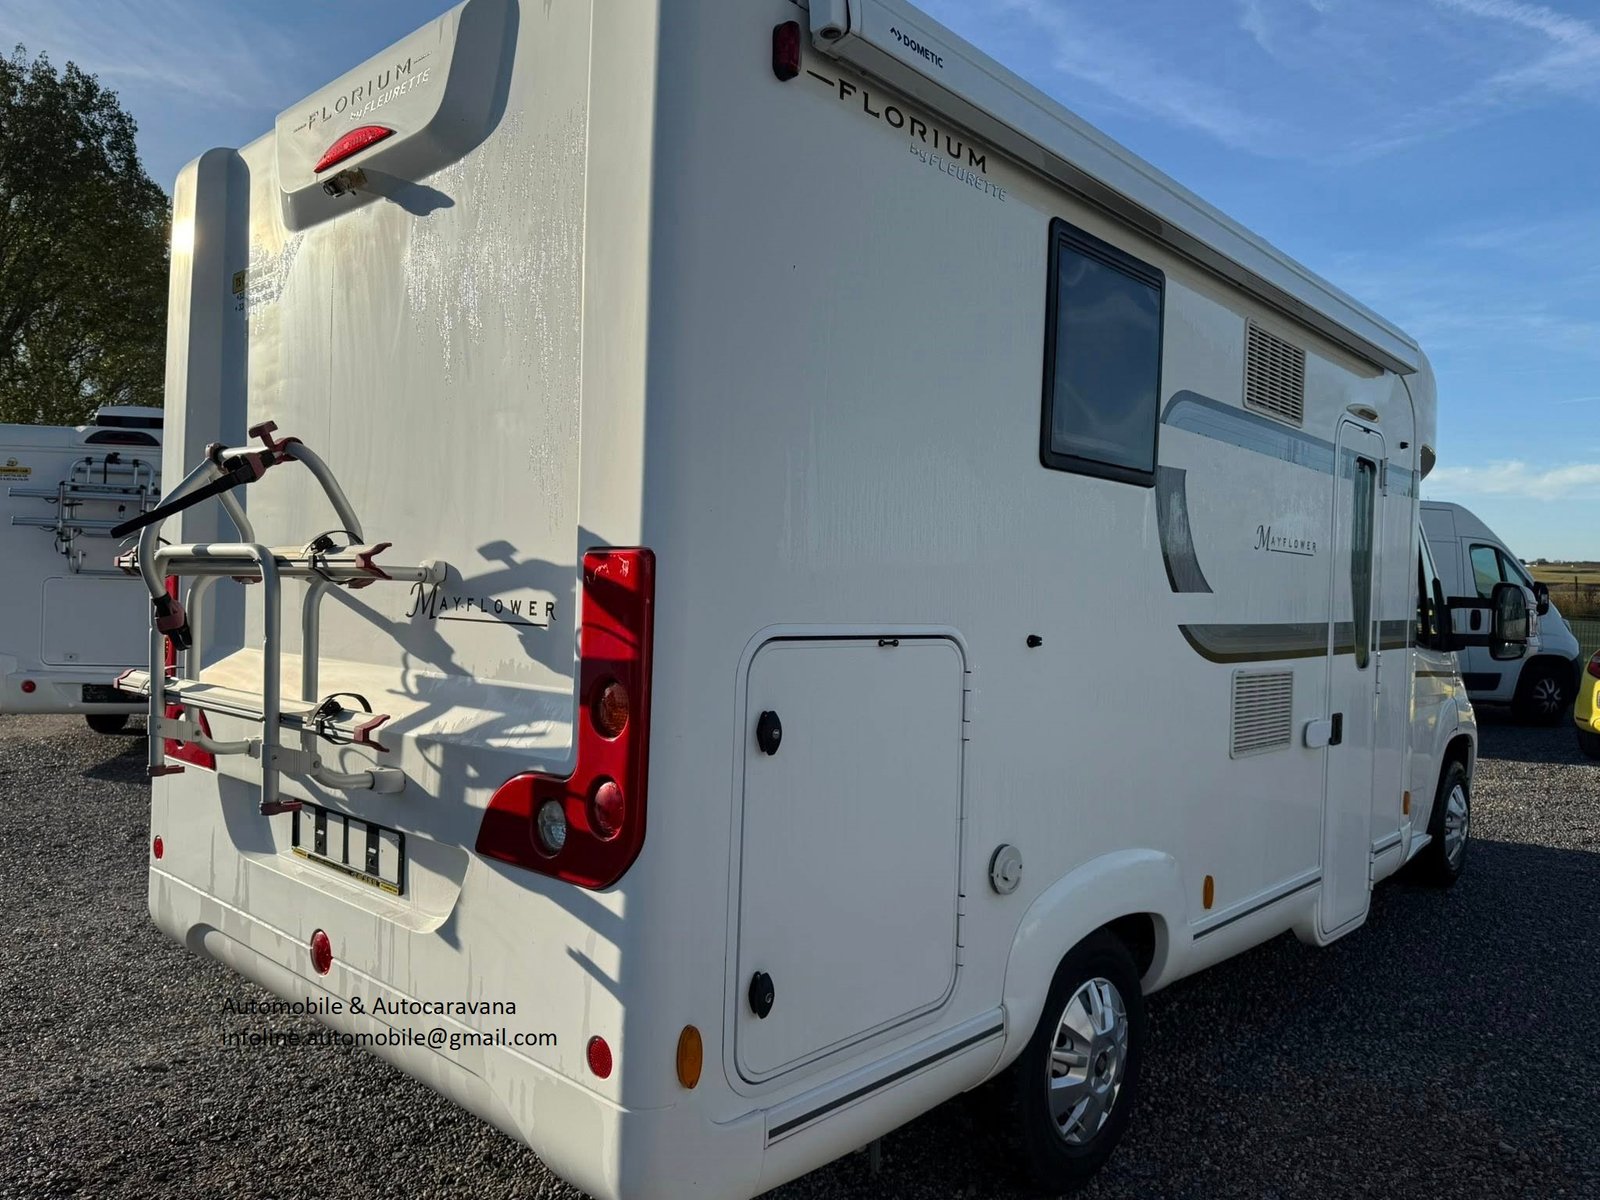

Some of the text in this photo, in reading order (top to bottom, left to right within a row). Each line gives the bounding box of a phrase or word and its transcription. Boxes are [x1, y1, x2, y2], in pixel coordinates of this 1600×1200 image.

[903, 34, 944, 69] DOMETIC
[308, 57, 411, 130] FLORIUM
[362, 67, 430, 117] FLEURETTE
[838, 78, 987, 173] FLORIUM
[929, 157, 1007, 202] FLEURETTE
[1254, 524, 1317, 553] MAYFLOWER
[405, 581, 557, 620] MAYFLOWER
